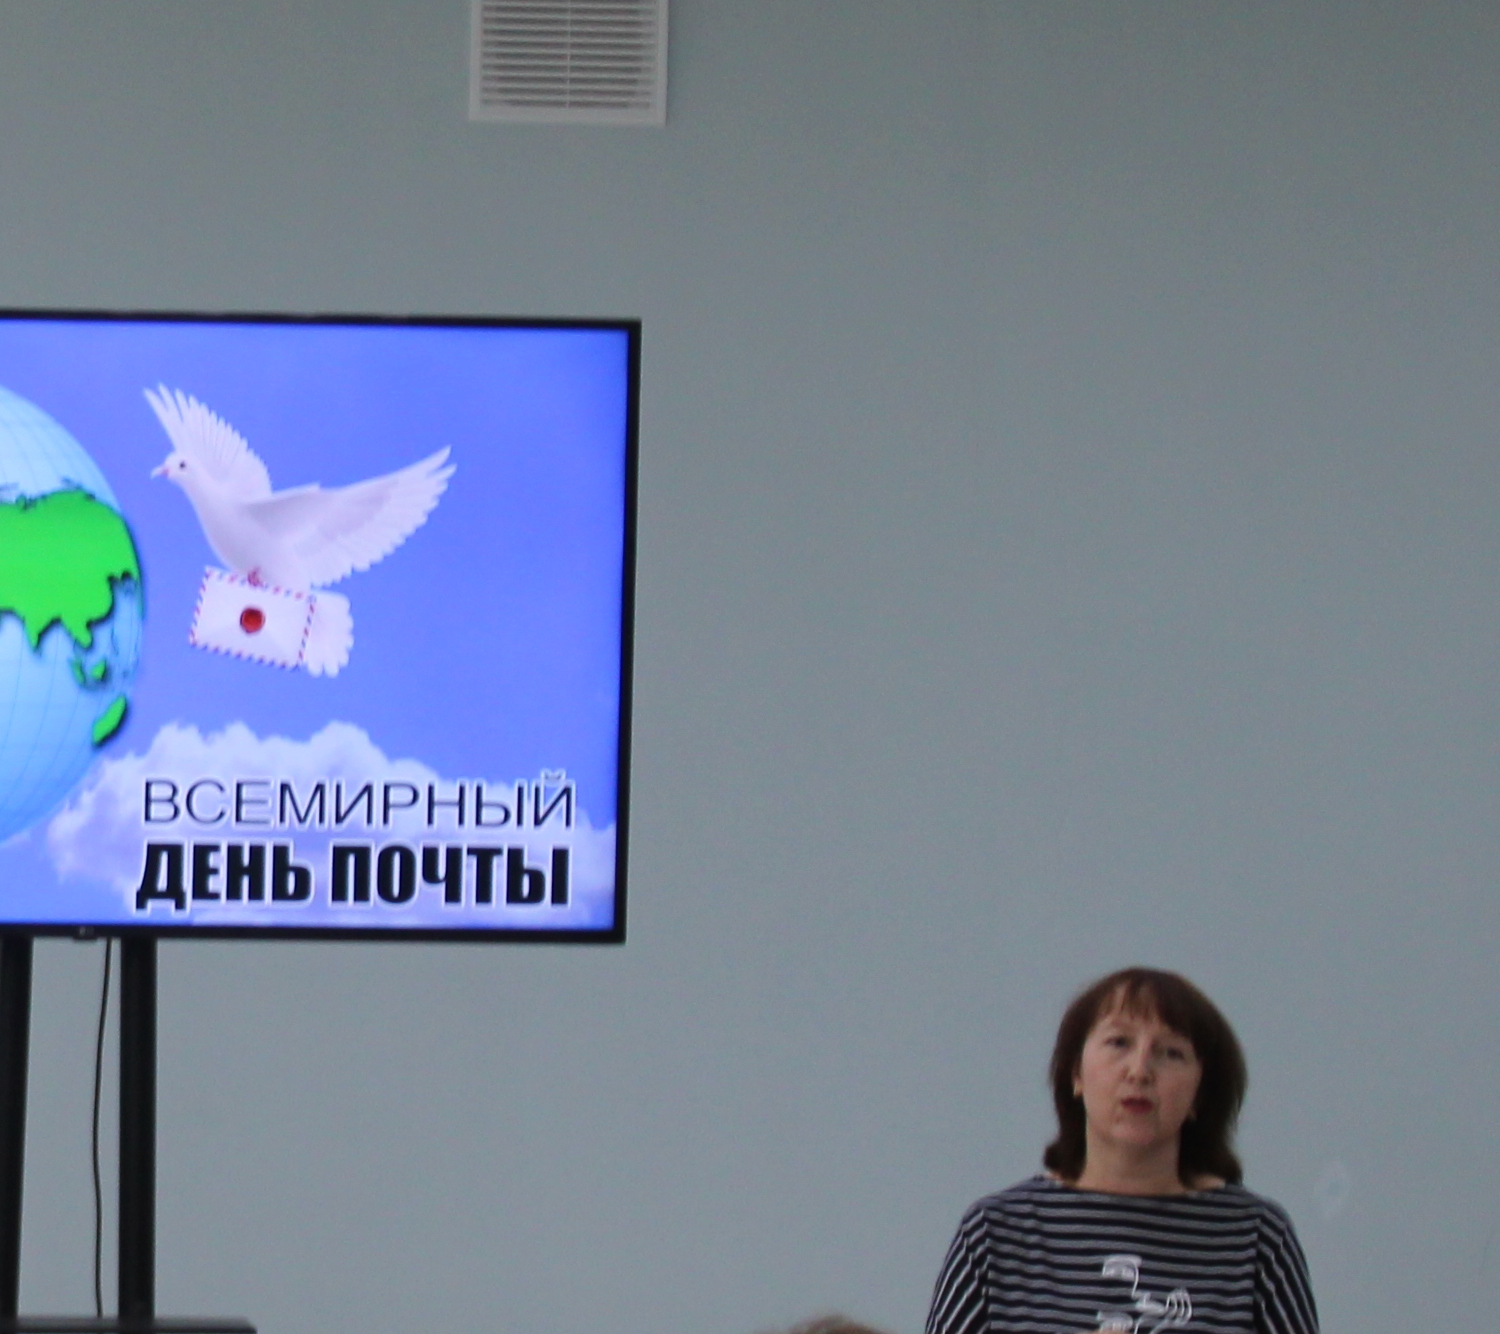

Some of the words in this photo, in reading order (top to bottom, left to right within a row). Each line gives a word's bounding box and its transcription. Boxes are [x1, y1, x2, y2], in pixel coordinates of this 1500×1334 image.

[142, 769, 576, 829] ВСЕМИРНЫЙ
[134, 841, 312, 912] ДЕНЬ
[329, 844, 571, 906] ПОЧТЫ
